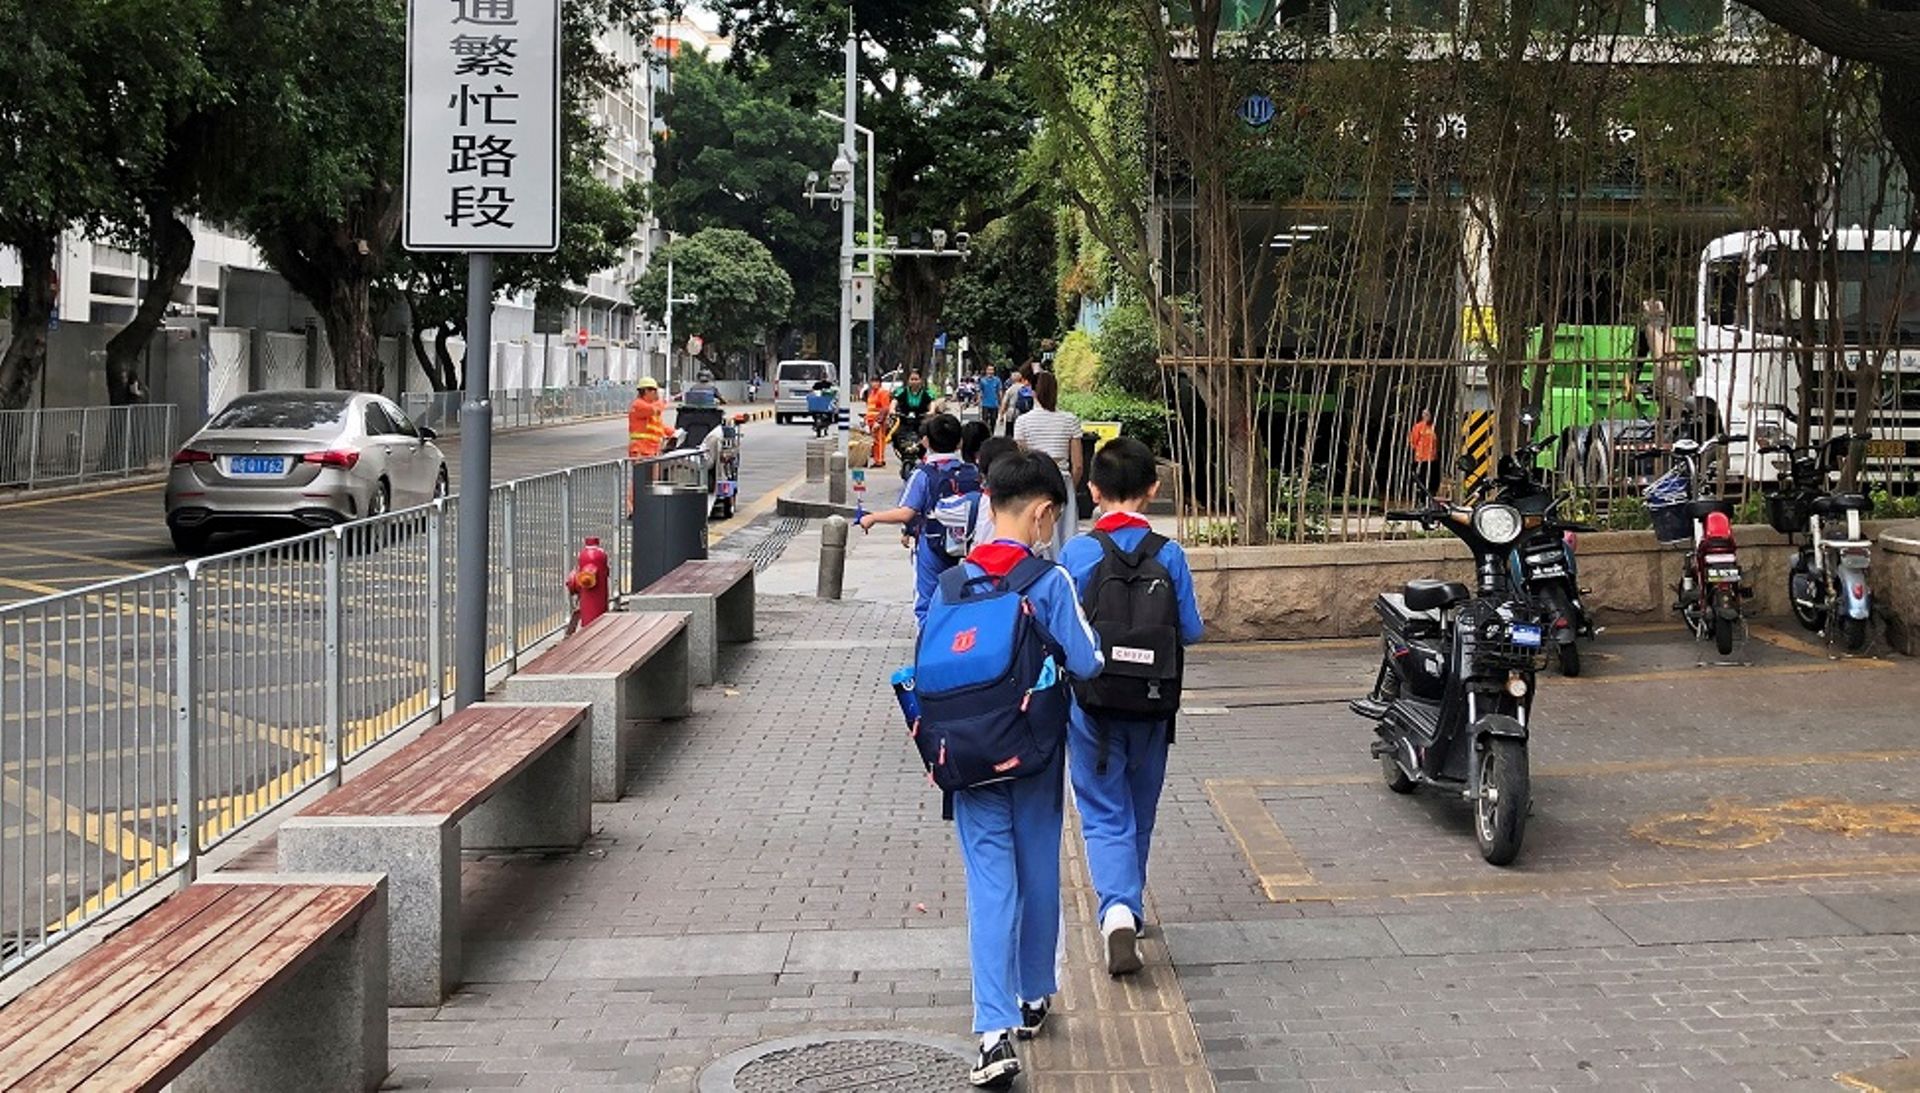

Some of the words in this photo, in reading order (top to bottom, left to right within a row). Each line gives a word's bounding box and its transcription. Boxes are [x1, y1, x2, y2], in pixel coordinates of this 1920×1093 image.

[444, 0, 519, 229] 通繁忙路段
